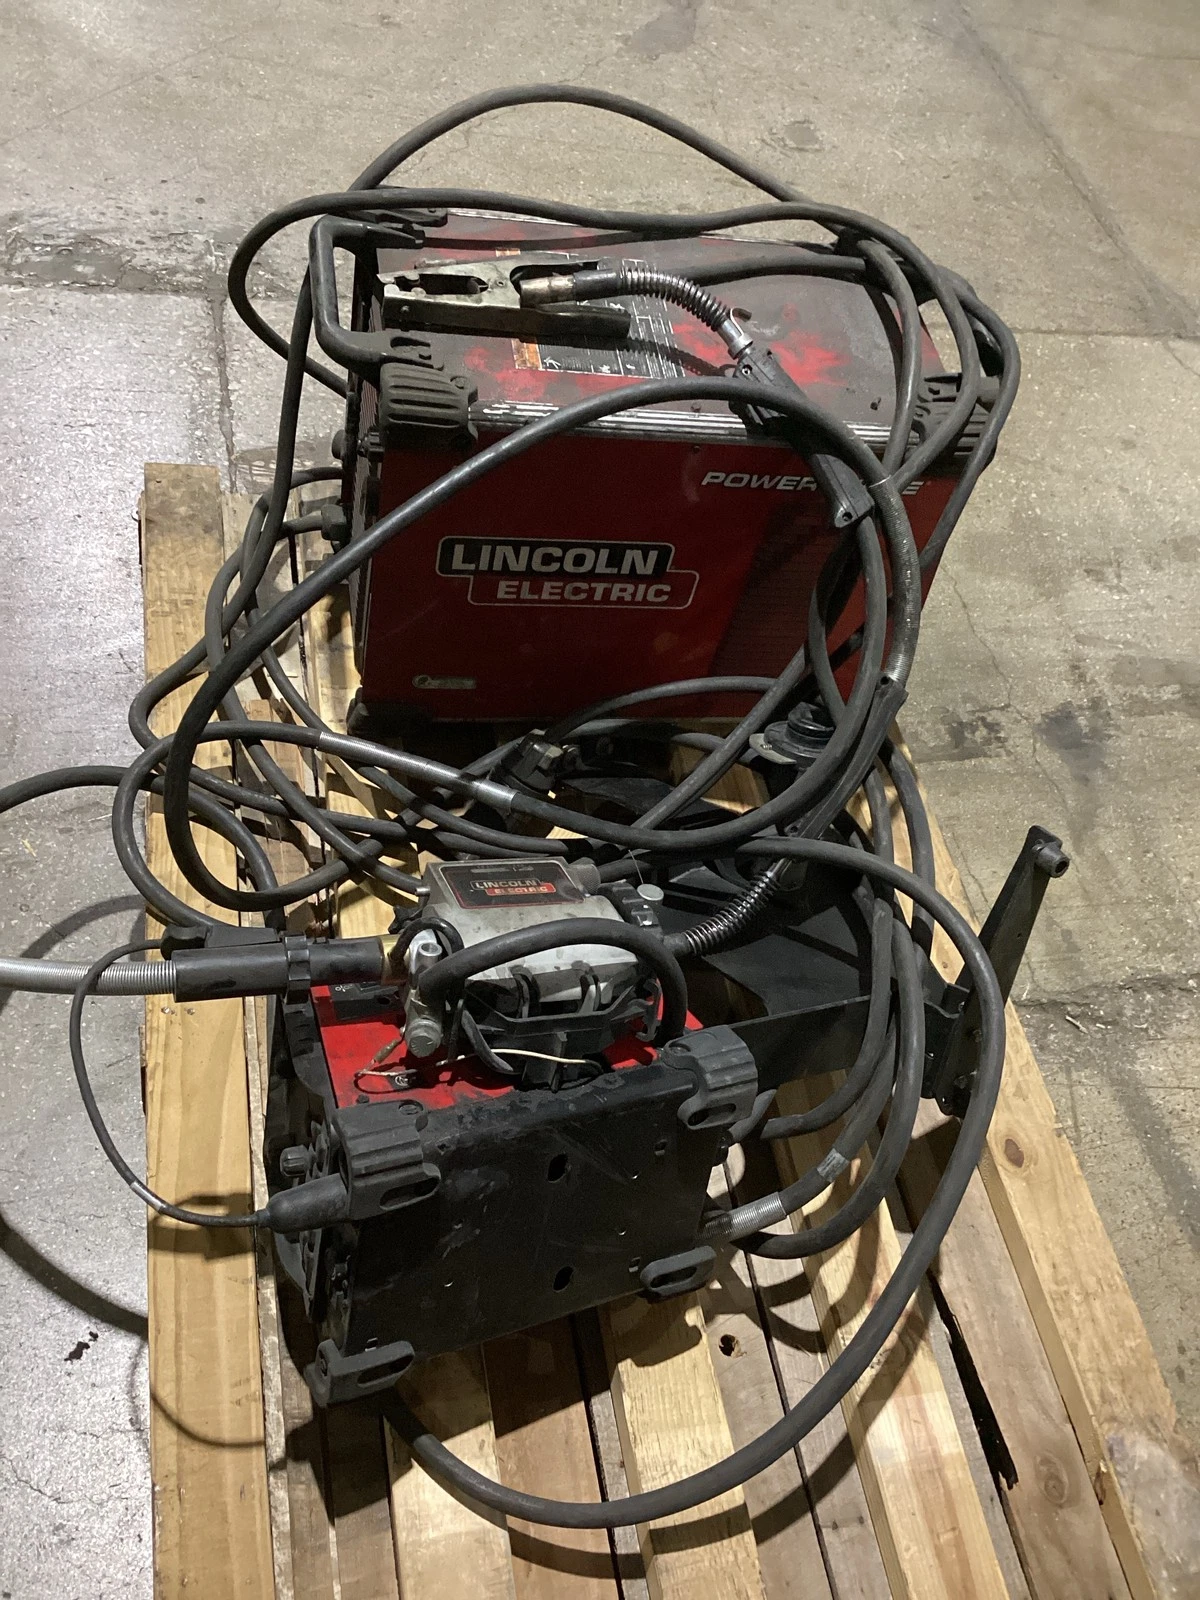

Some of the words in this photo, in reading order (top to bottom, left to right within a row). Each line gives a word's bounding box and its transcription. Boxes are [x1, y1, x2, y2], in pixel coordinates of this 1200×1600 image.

[701, 471, 818, 492] POWER
[451, 544, 658, 574] LINCOLN
[496, 580, 671, 602] ELECTRIC
[474, 879, 538, 889] LINCOLN
